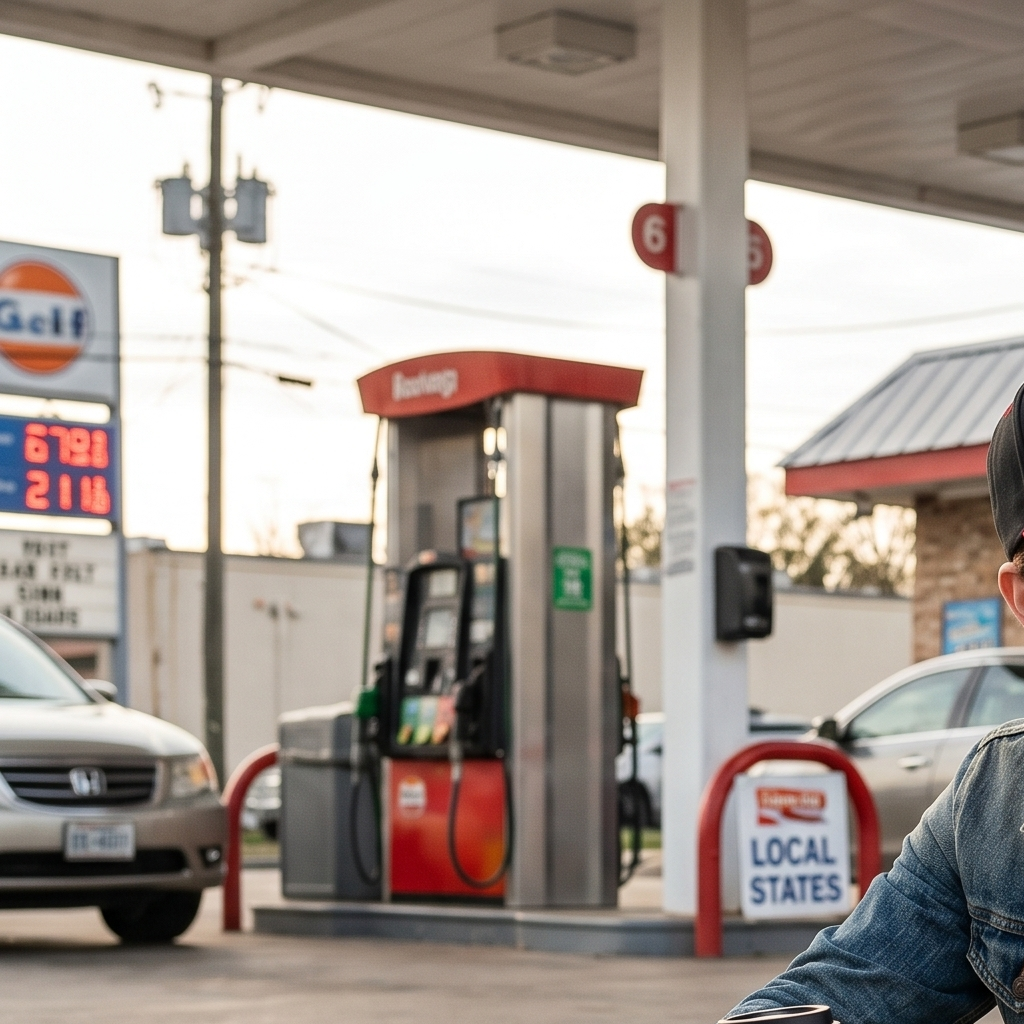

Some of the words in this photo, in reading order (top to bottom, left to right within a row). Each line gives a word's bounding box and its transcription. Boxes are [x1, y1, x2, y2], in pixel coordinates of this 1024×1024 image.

[643, 214, 667, 254] 6
[751, 836, 837, 867] LOCAL
[751, 874, 842, 905] STATES
